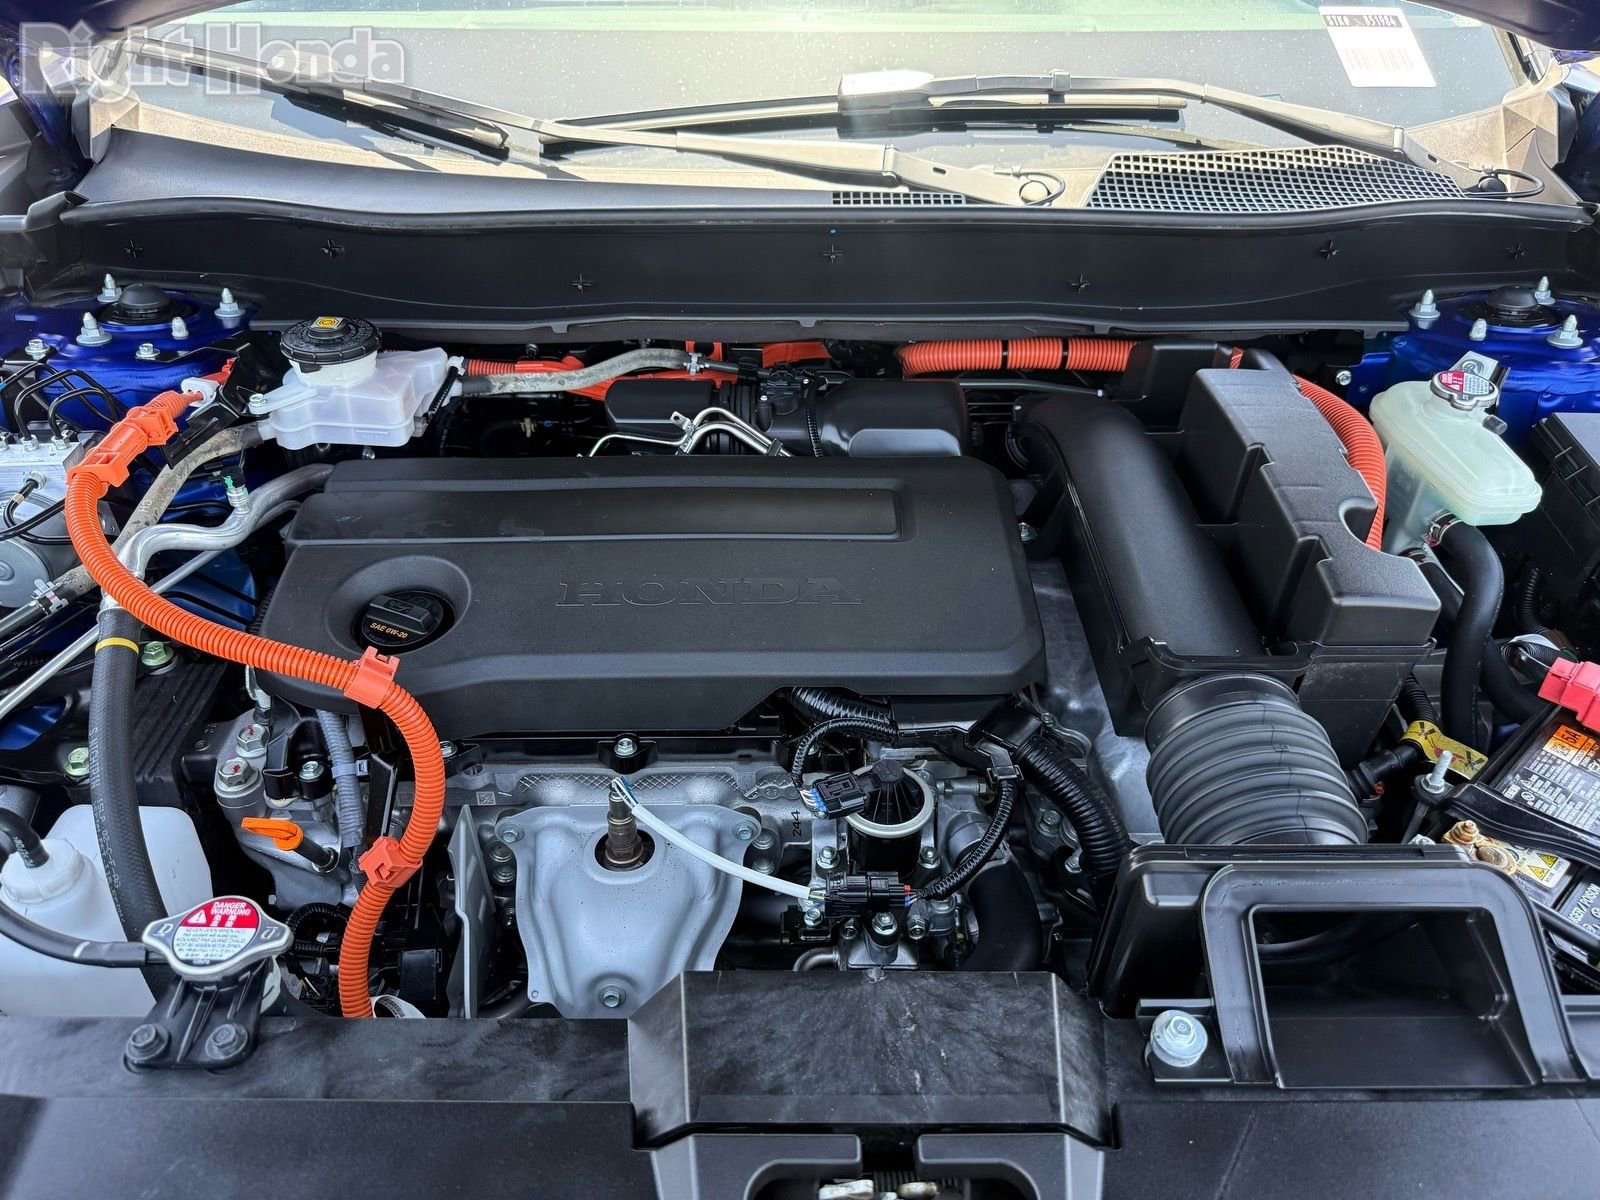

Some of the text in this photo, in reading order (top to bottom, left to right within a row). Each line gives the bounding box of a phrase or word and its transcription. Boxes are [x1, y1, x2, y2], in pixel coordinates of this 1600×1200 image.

[555, 578, 863, 607] HONDA
[369, 622, 409, 640] SAE 0W-20
[790, 810, 802, 837] 244
[212, 901, 247, 909] DANGER
